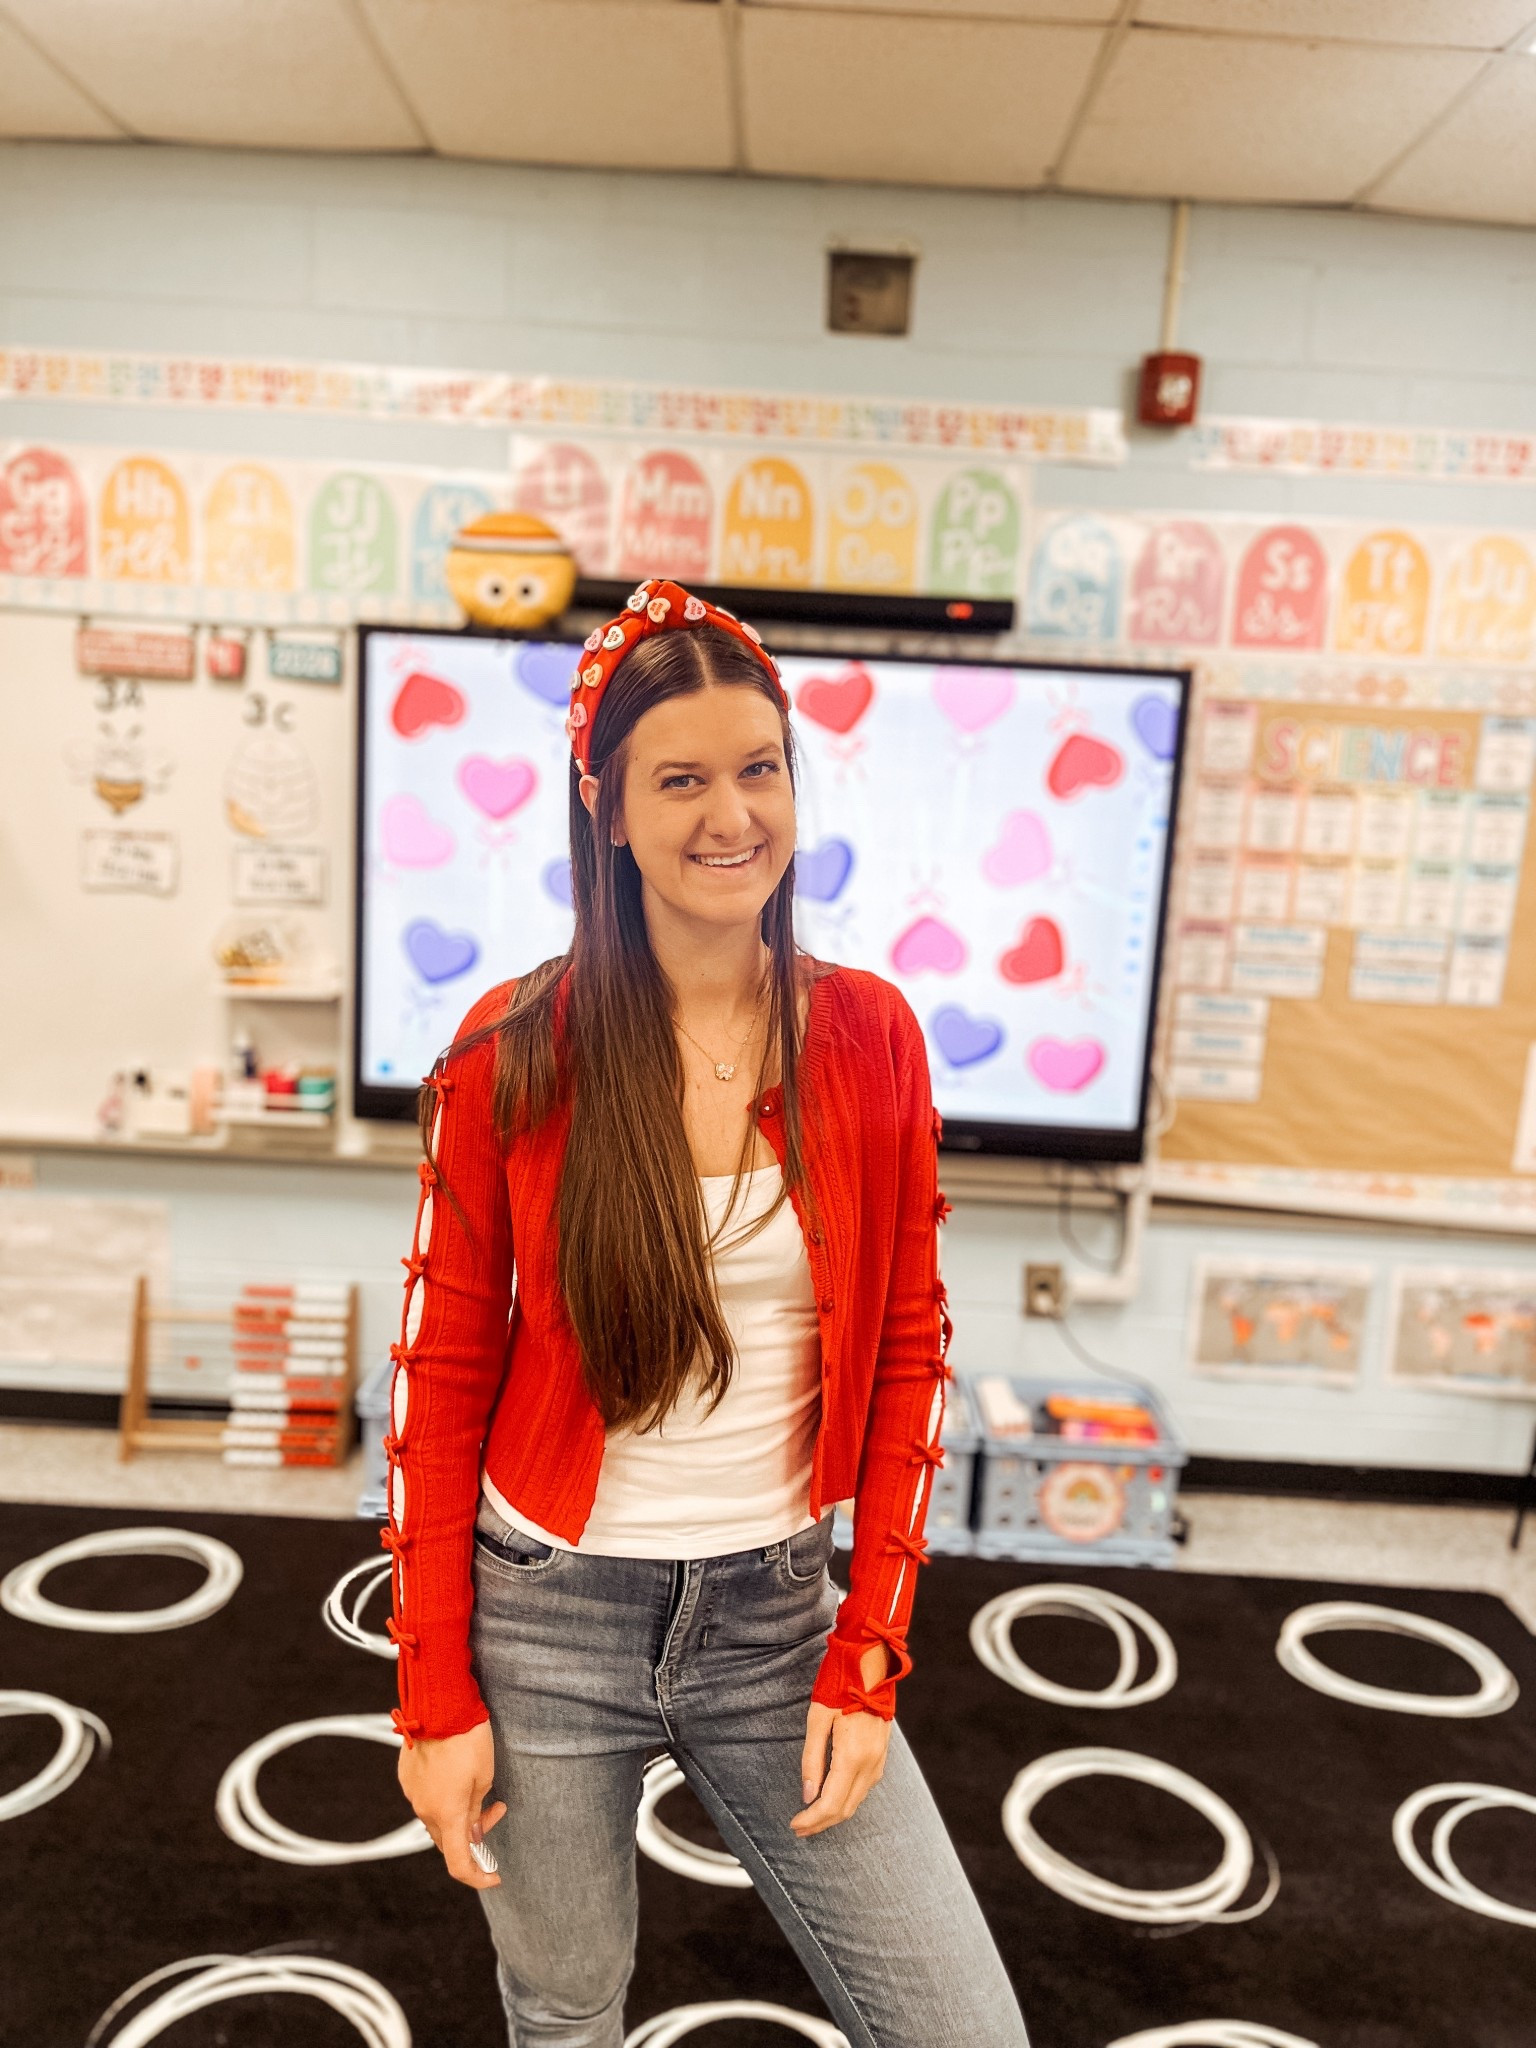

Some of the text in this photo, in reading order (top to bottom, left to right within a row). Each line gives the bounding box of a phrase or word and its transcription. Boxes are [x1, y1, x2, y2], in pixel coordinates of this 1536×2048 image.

[7, 459, 70, 526] Gg
[113, 469, 176, 520] Hh
[327, 477, 381, 543] Jj
[630, 468, 708, 515] Mm
[739, 469, 799, 521] Nn
[836, 475, 914, 529] Oo
[948, 477, 1006, 538] Pp
[1260, 540, 1314, 592] Ss
[1366, 542, 1419, 592] Tt
[1266, 719, 1466, 788] SCIENCE
